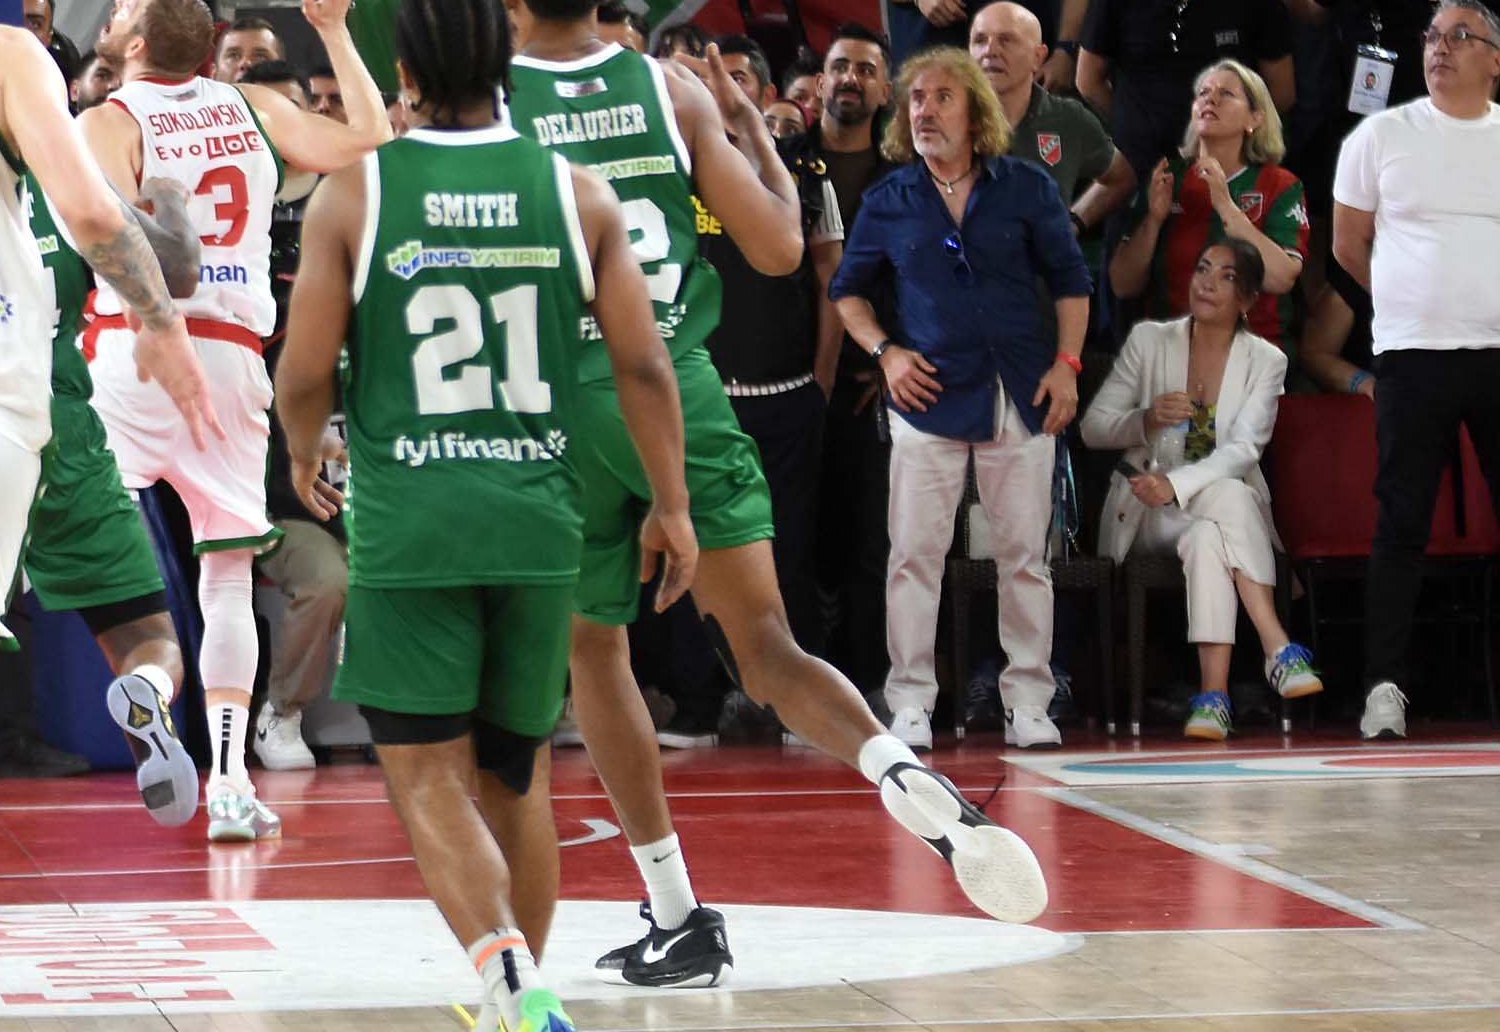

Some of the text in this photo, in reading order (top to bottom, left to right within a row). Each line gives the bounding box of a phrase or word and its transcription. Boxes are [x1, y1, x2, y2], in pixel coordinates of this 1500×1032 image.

[532, 103, 648, 147] DELAURIER
[424, 192, 519, 228] SMITH
[405, 284, 553, 415] 21
